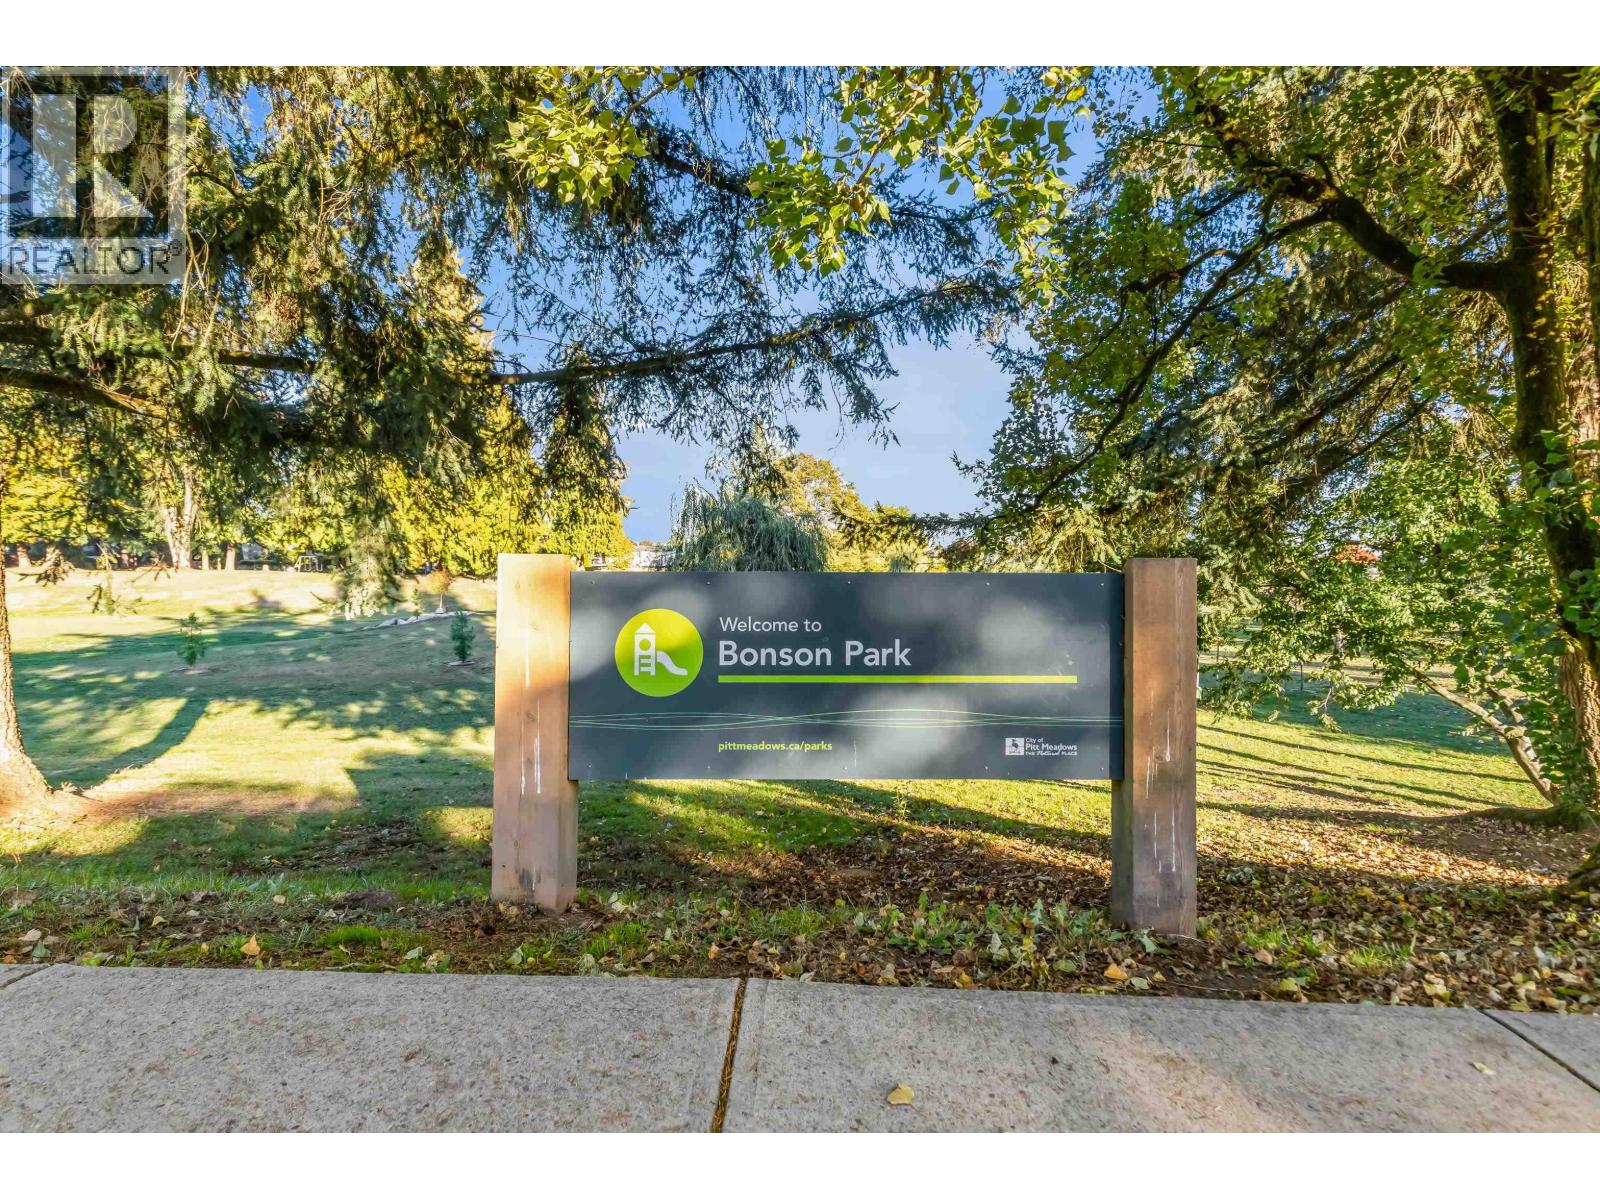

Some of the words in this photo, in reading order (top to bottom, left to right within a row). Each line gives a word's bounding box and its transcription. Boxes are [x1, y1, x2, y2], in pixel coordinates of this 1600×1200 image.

[719, 616, 798, 632] Welcome
[803, 618, 822, 632] to
[719, 640, 832, 666] Bonson
[845, 638, 911, 666] Park
[718, 740, 833, 752] pittmeadows.ca/parks
